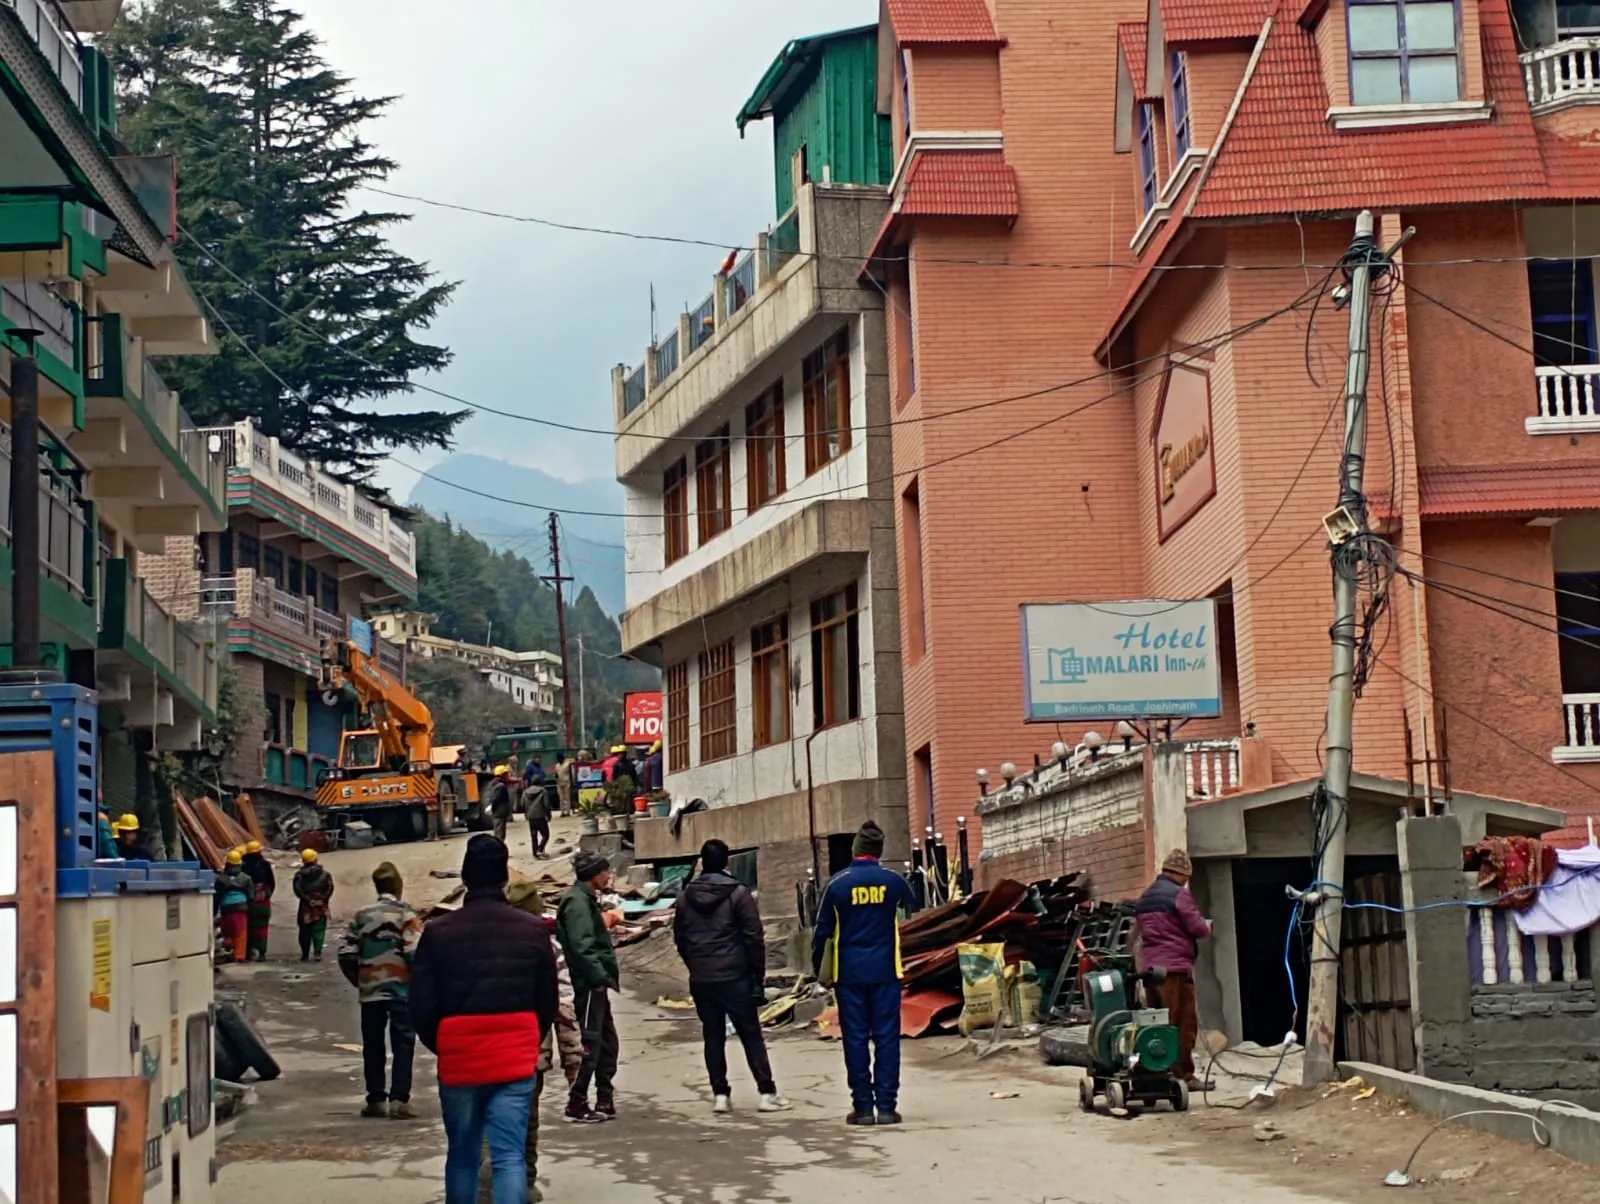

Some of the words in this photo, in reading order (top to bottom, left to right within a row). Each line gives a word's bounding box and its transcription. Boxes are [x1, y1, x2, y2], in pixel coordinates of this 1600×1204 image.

[1113, 622, 1206, 649] Hotel
[1086, 655, 1159, 674] MALARI
[630, 718, 663, 736] MO
[342, 782, 408, 798] ECORTS
